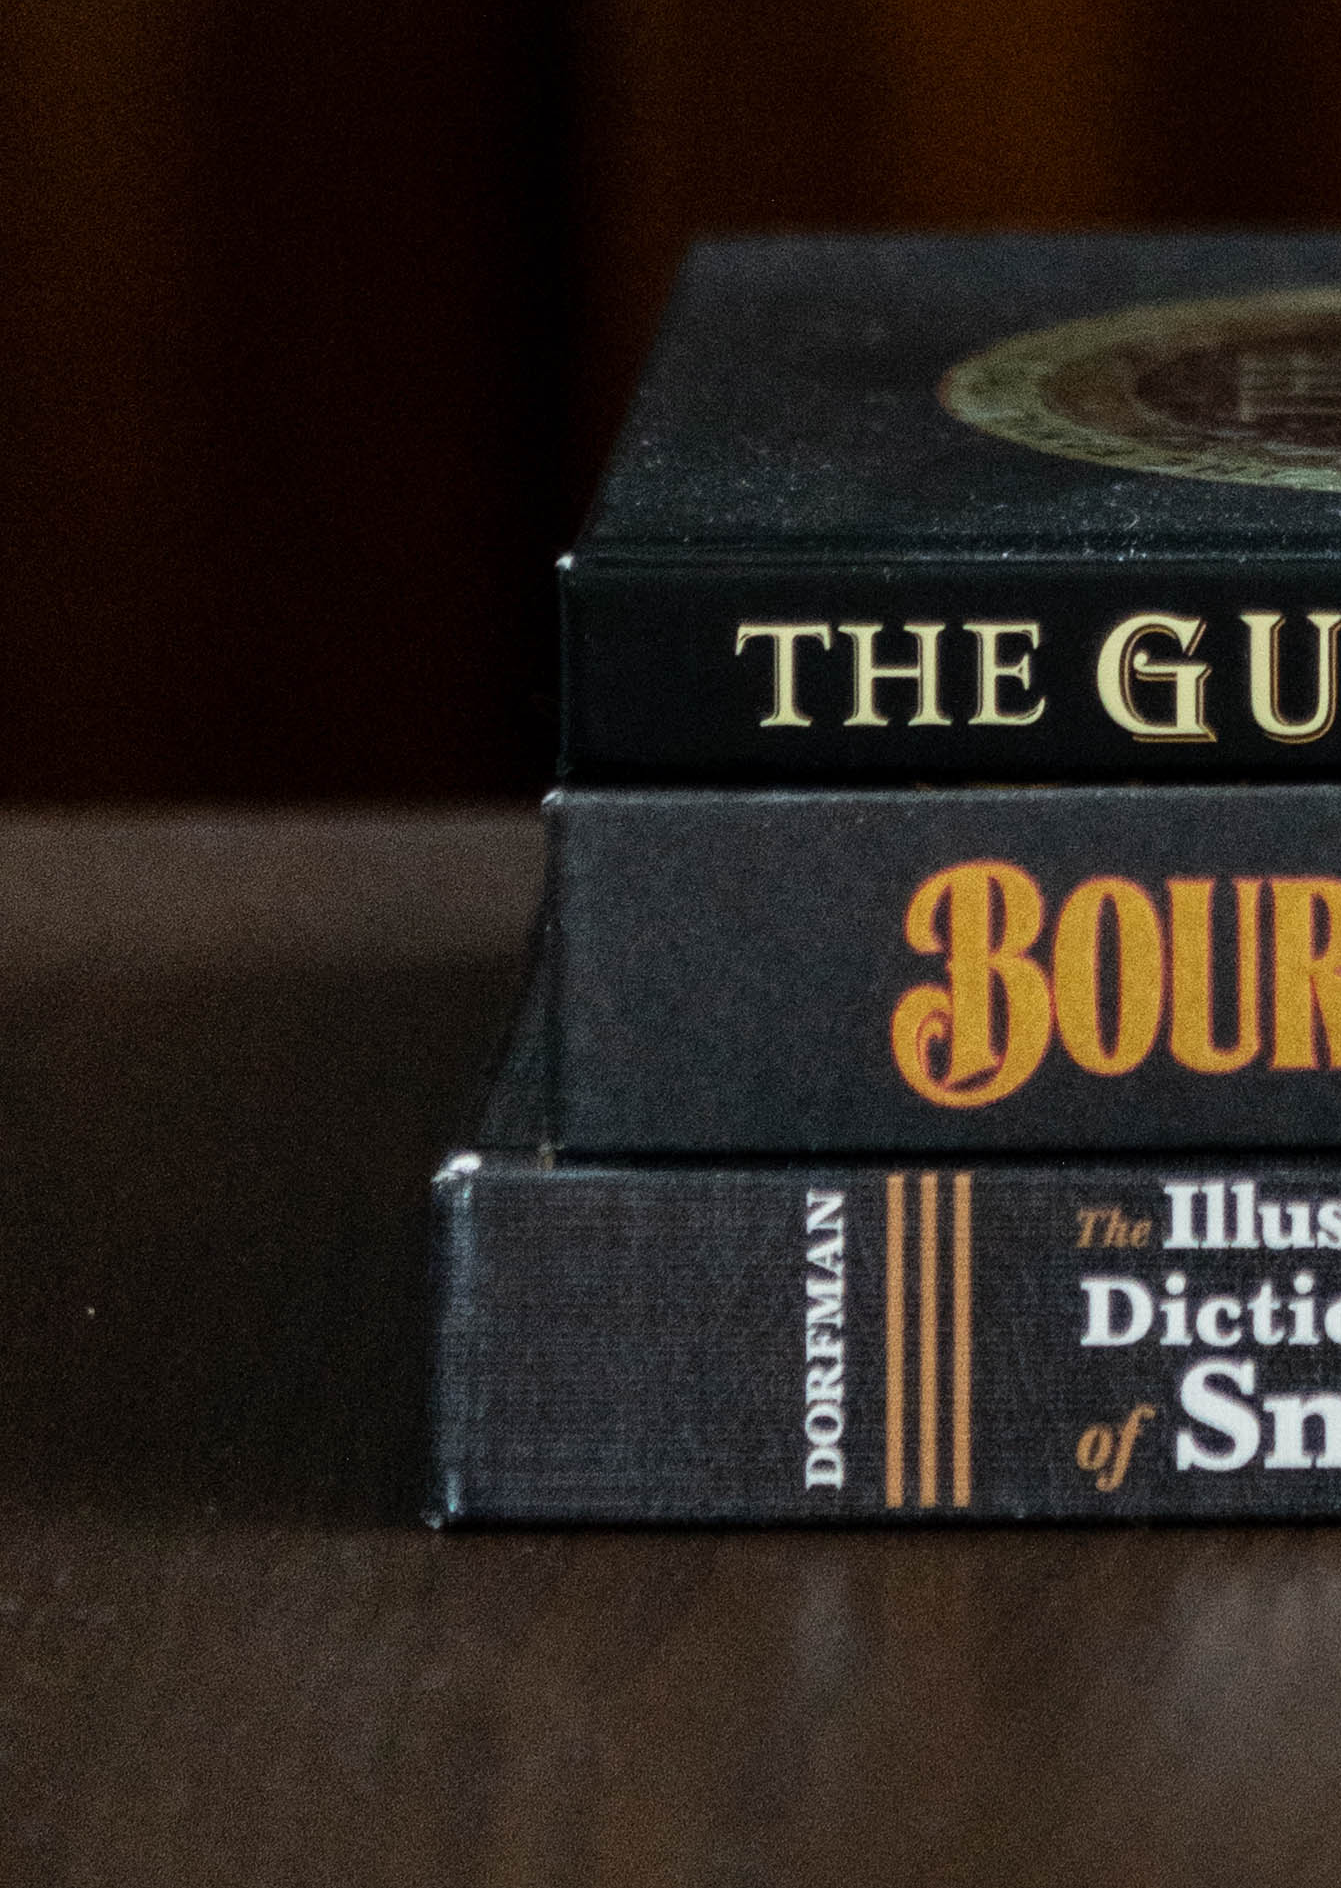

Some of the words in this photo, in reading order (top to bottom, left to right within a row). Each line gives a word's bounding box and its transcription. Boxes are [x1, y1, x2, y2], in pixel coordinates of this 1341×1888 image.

[735, 621, 1048, 729] THE
[1075, 1207, 1153, 1250] The
[803, 1189, 846, 1492] DORFMAN
[1075, 1403, 1156, 1493] of
